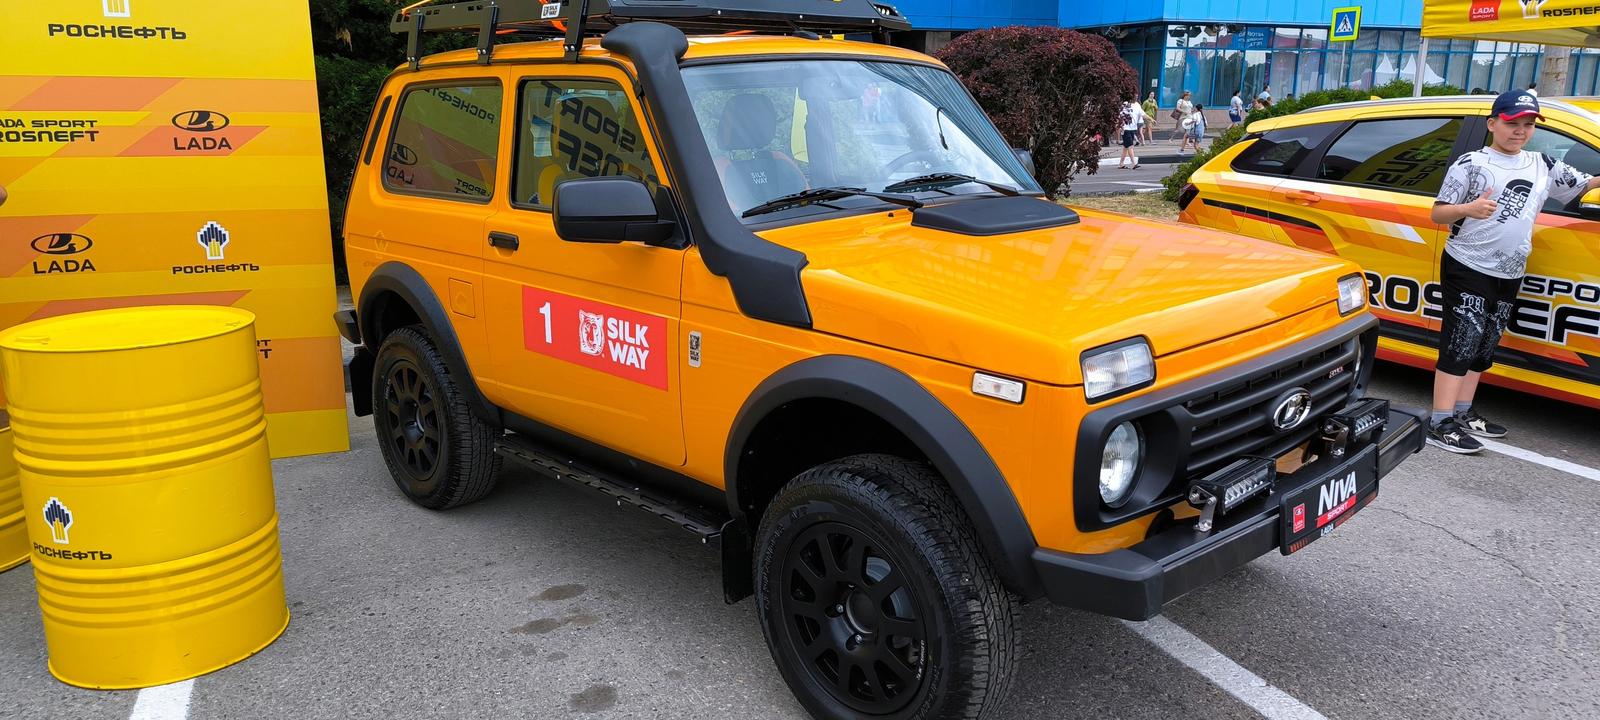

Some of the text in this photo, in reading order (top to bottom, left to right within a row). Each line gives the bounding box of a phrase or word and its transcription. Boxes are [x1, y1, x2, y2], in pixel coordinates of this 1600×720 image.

[1472, 7, 1495, 15] LADA
[48, 23, 187, 40] РОСНЕФТЬ
[31, 119, 98, 128] SPORT
[173, 137, 232, 151] LADA
[1497, 188, 1512, 206] THE
[1497, 192, 1519, 224] NORTH
[1511, 196, 1528, 219] FACE
[32, 259, 97, 275] LADA
[172, 263, 260, 275] РОСНЕФТЬ
[539, 302, 552, 344] 1
[607, 317, 649, 348] SILK
[608, 340, 649, 370] WAY
[33, 541, 112, 560] РОСНЕФТЬ
